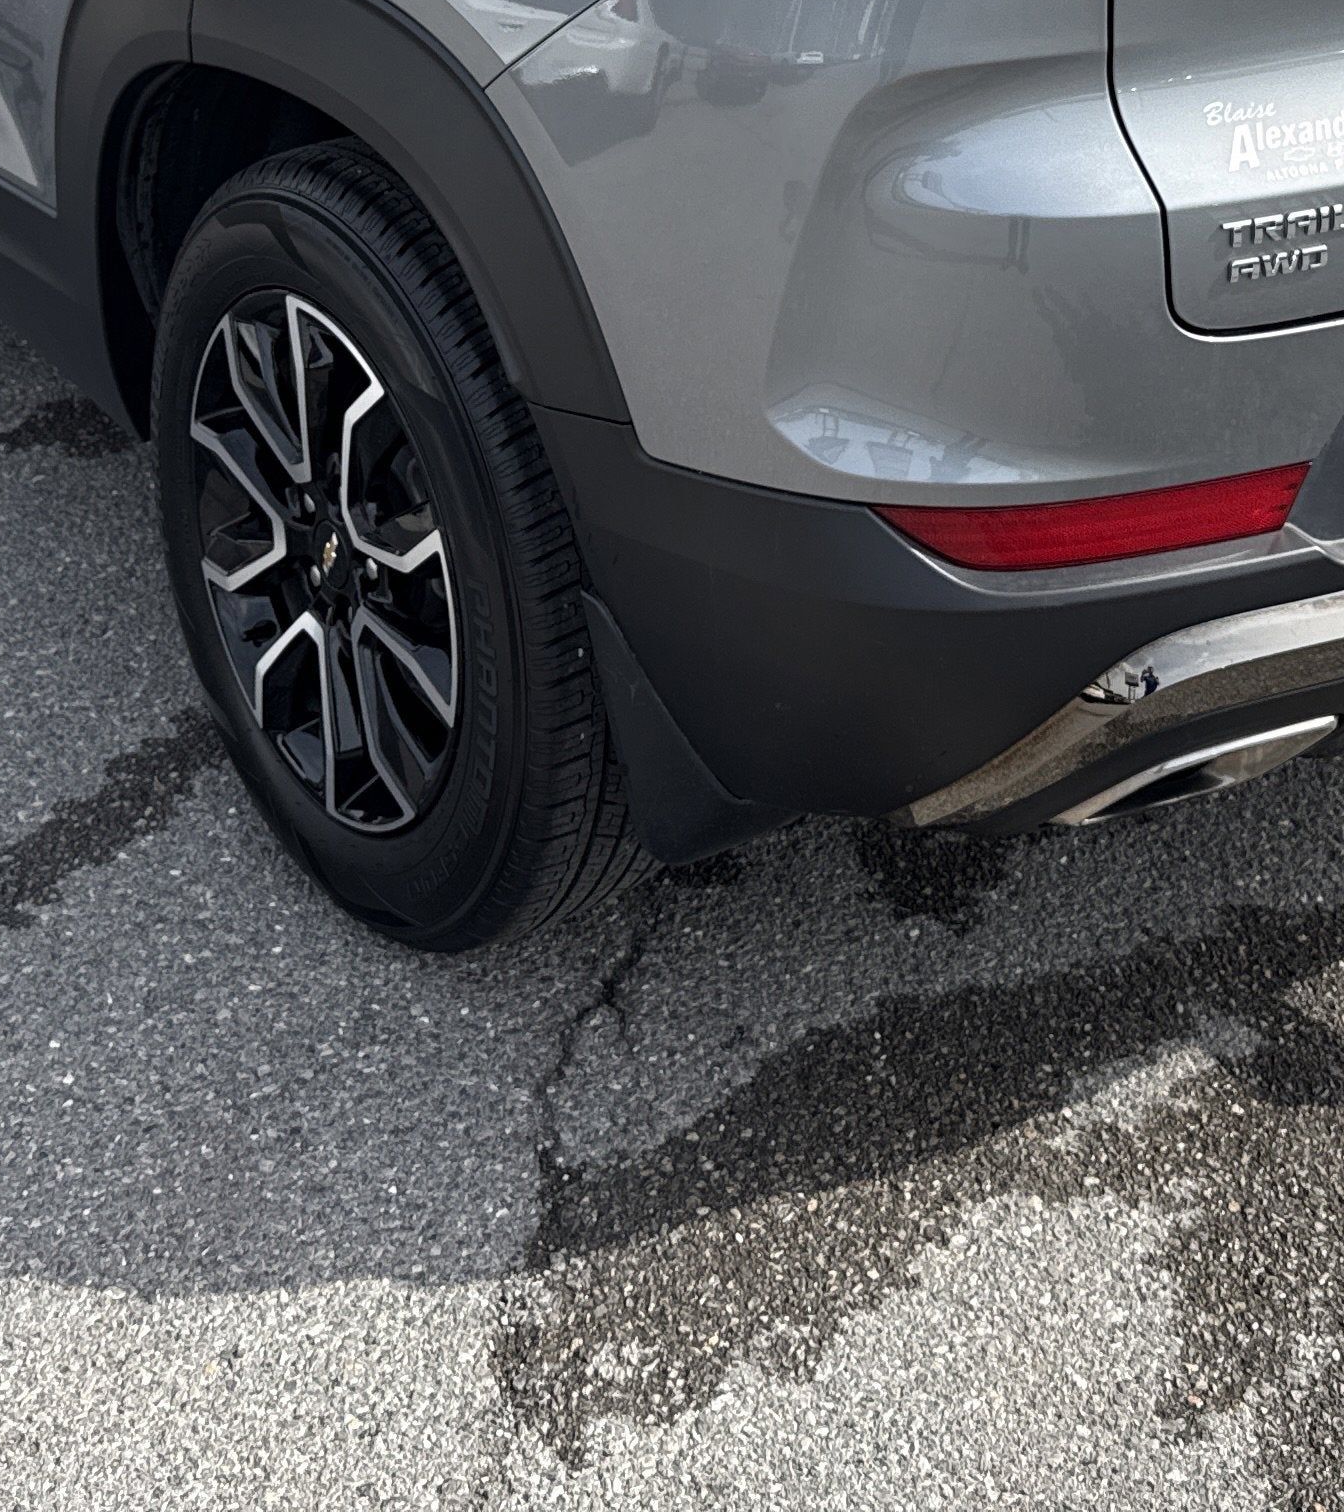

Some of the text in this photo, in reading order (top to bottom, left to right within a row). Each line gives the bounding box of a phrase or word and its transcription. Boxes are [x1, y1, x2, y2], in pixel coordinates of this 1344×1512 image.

[1203, 101, 1277, 126] Blaise
[1265, 161, 1329, 182] ALTOONA
[1227, 243, 1329, 284] AWD
